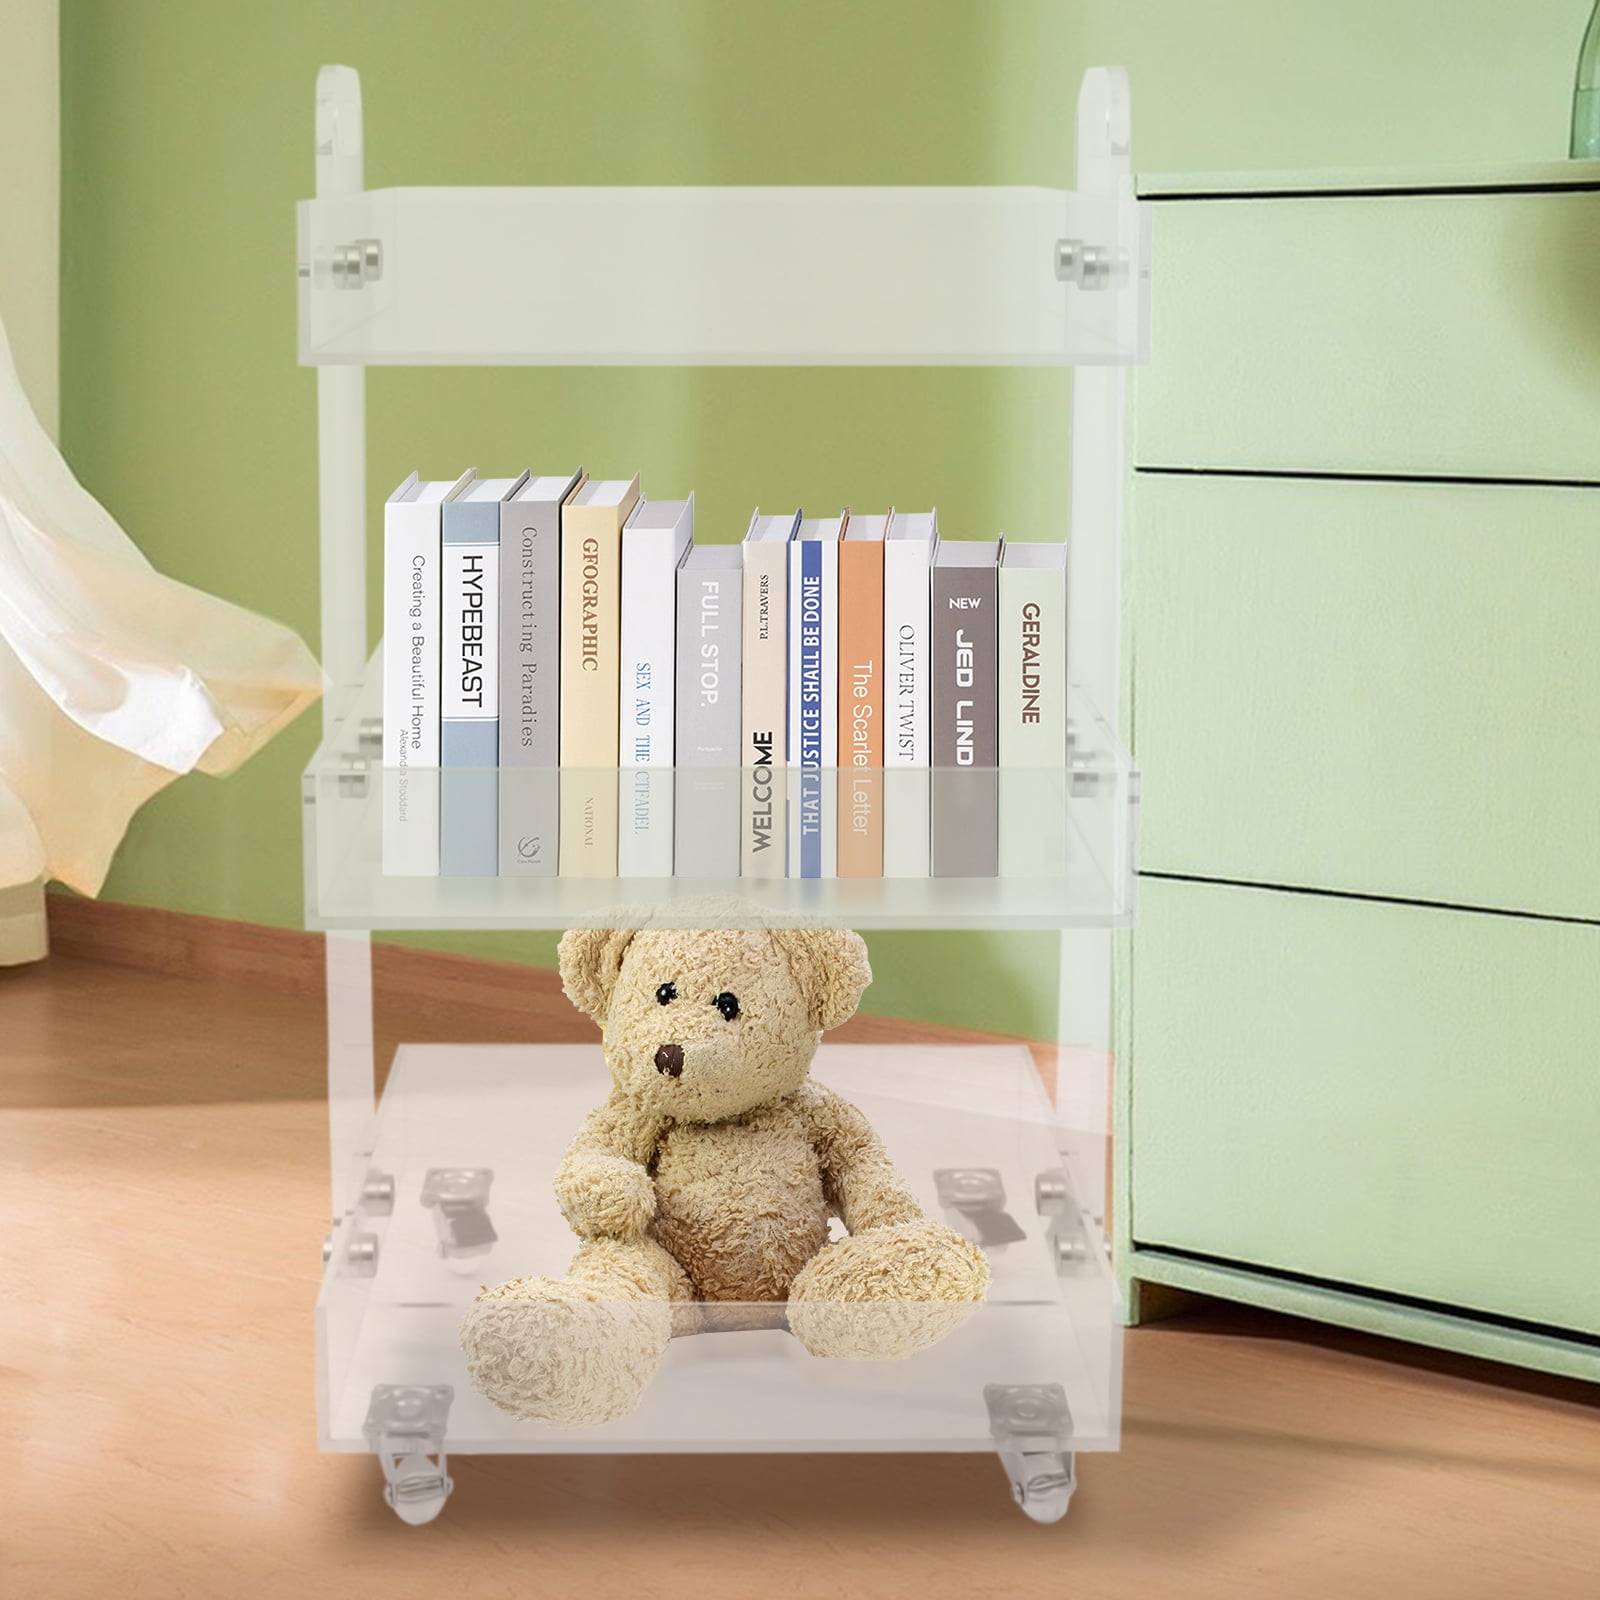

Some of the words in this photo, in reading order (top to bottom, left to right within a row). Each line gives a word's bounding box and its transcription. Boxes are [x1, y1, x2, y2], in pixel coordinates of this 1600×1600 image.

[409, 555, 425, 617] Creating
[519, 526, 537, 652] Constructing
[582, 537, 598, 671] GFOGRAPHIC
[701, 581, 718, 637] FULL
[760, 574, 769, 640] P.L.TRAVERS
[803, 576, 819, 622] DONE
[949, 598, 981, 609] NEW
[412, 622, 421, 631] a
[462, 555, 482, 708] HYPEBEAST
[803, 626, 819, 645] BE
[411, 636, 425, 700] Beautiful
[635, 662, 650, 690] SEX
[701, 643, 718, 707] STOP.
[803, 650, 819, 701] SHALL
[853, 660, 872, 698] The
[898, 624, 915, 694] OLIVER
[956, 629, 974, 688] JED
[1022, 602, 1041, 724] GERALDINE
[411, 705, 424, 749] Home
[521, 663, 537, 747] Paradies
[635, 698, 650, 726] AND
[898, 700, 915, 761] TWIST
[956, 700, 974, 766] LIND
[635, 735, 650, 762] THE
[803, 708, 819, 781] JUSTICE
[853, 704, 872, 772] Scarlet
[398, 778, 408, 822] Stoddard
[753, 731, 773, 853] WELCOME
[803, 787, 819, 835] THAT
[853, 778, 872, 835] Letter
[584, 797, 594, 848] NATIONAL
